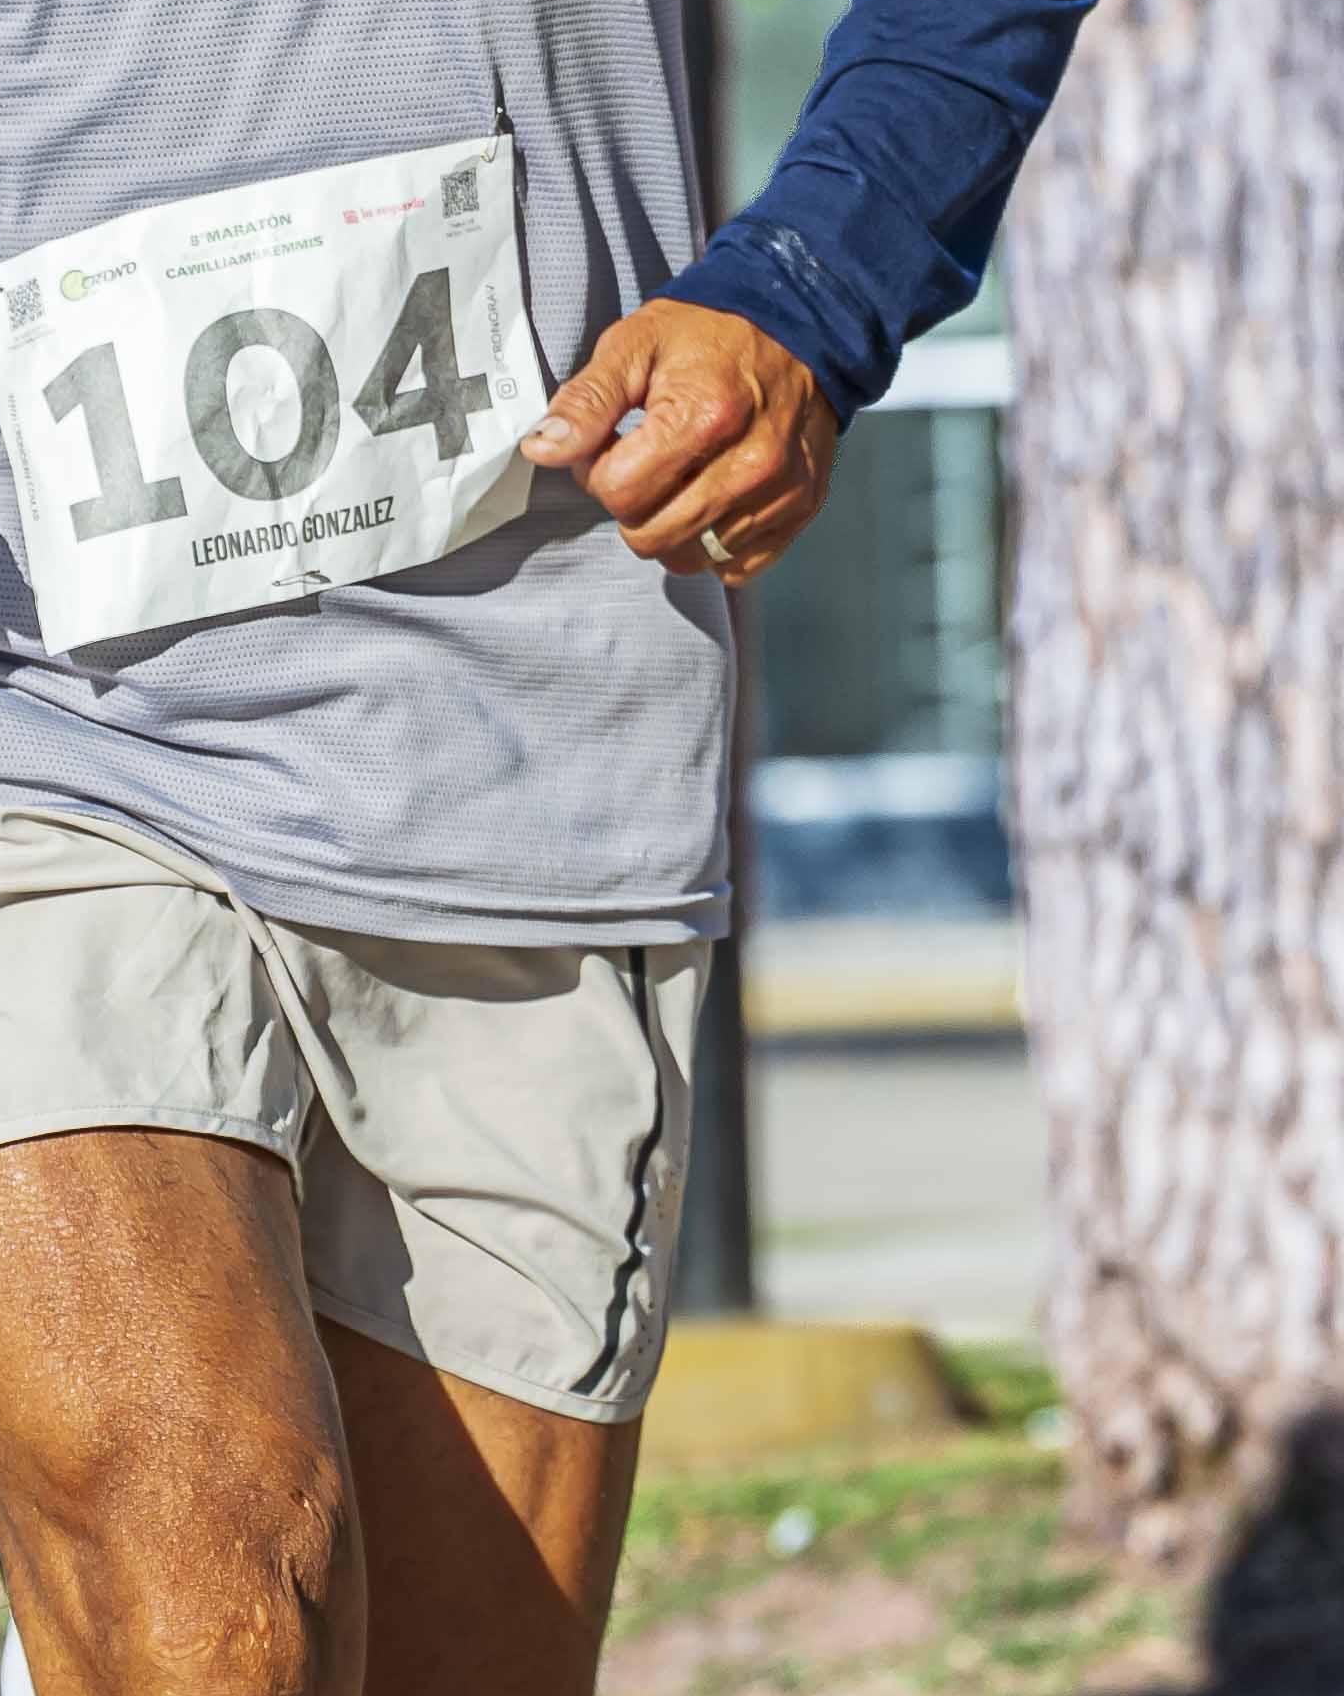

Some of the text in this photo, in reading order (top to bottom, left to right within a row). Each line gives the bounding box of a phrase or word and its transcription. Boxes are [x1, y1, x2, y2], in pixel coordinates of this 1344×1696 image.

[165, 234, 325, 281] CAWILLIAMSEMMIS
[43, 267, 494, 543] 104
[192, 495, 395, 567] LEONARDO GONZALEZ
